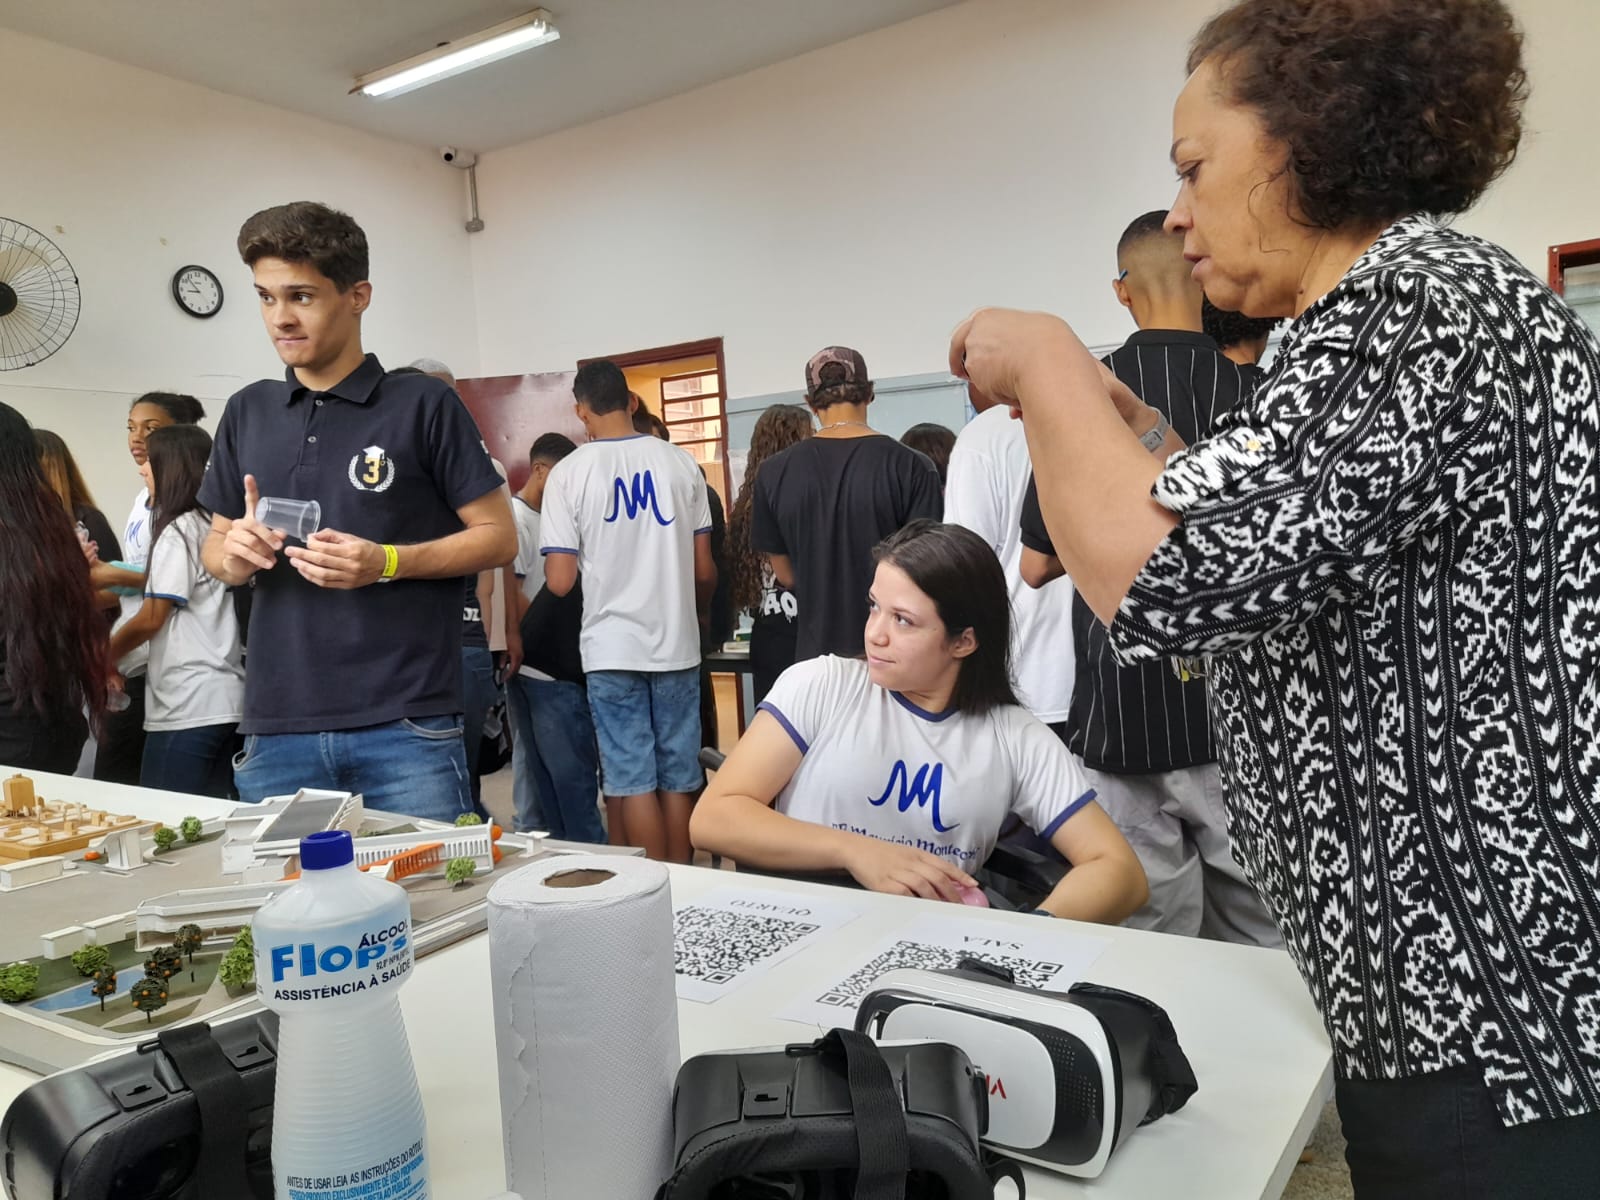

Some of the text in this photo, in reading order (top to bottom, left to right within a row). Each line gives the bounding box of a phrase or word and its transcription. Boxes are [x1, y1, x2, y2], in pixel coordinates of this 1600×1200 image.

[964, 936, 1024, 950] SALA
[274, 979, 367, 1001] ASSISTÊNCIA
[369, 973, 379, 988] À
[381, 958, 411, 984] SAÚDE
[287, 1175, 304, 1189] ANTES
[304, 1177, 313, 1190] DE
[313, 1176, 332, 1190] USAR
[332, 1174, 348, 1188] LEIA
[350, 1171, 360, 1185] AS
[361, 1156, 401, 1181] INSTRUÇÕES
